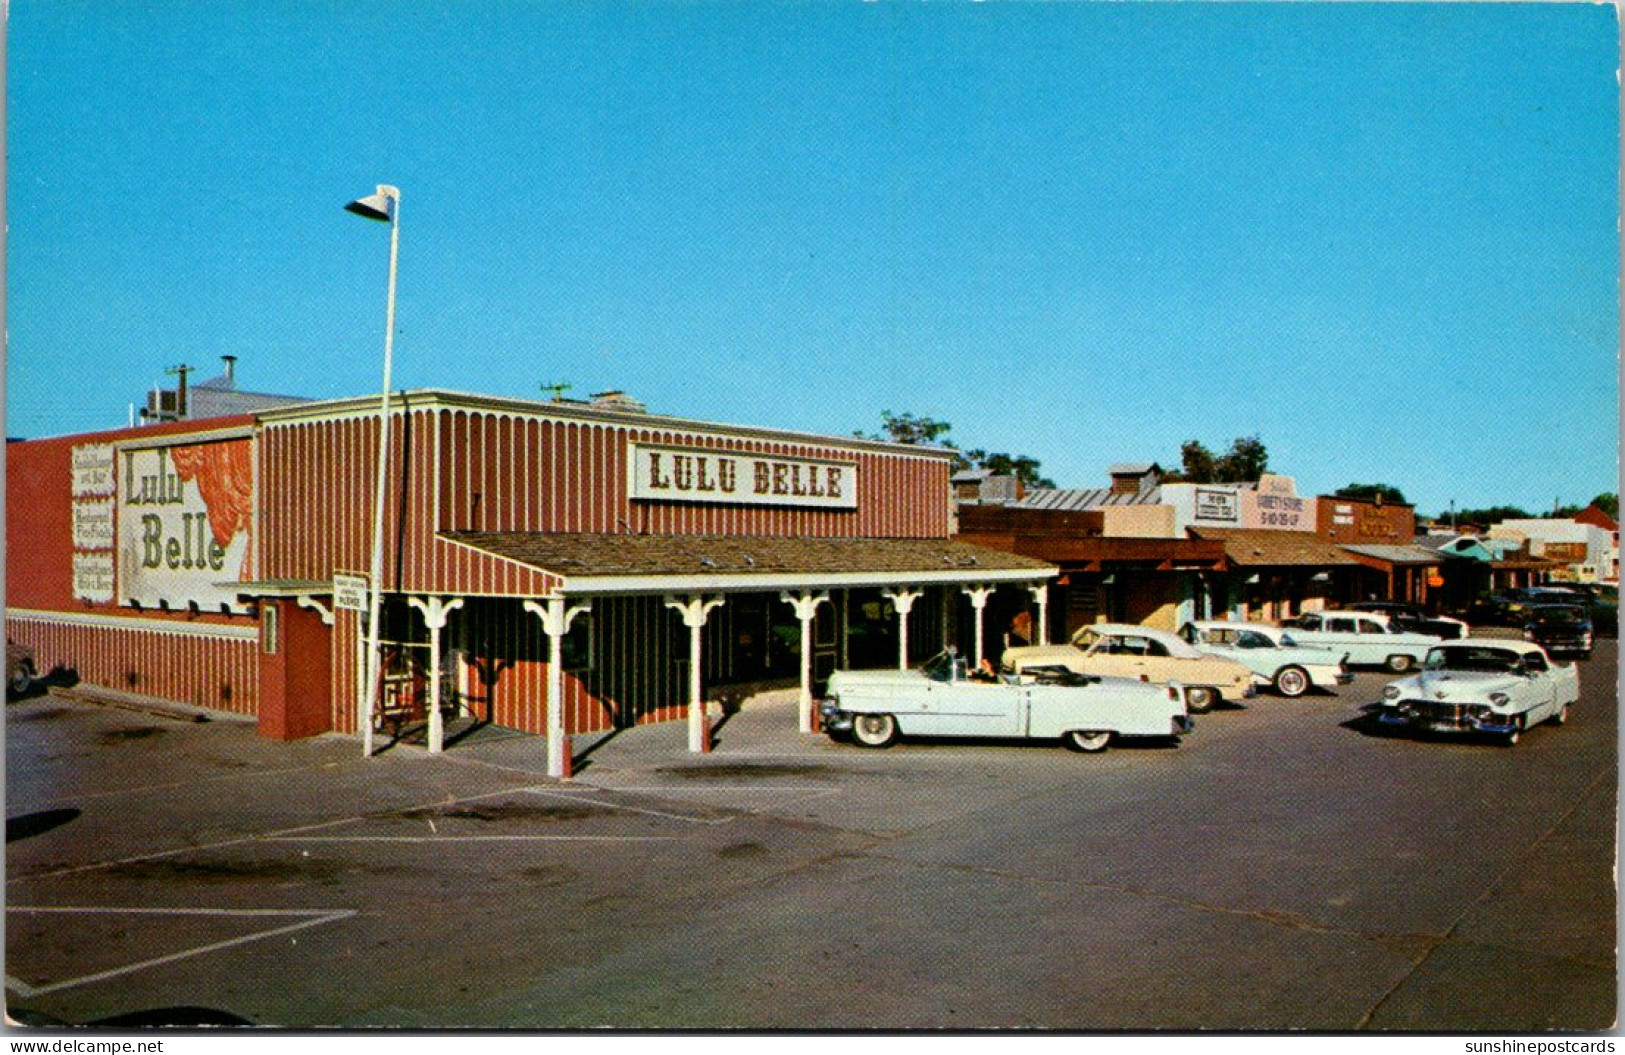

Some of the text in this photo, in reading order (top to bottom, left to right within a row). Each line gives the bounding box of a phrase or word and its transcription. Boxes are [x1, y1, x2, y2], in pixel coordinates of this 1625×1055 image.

[649, 452, 843, 498] LULU BELLE
[141, 512, 225, 571] Belle
